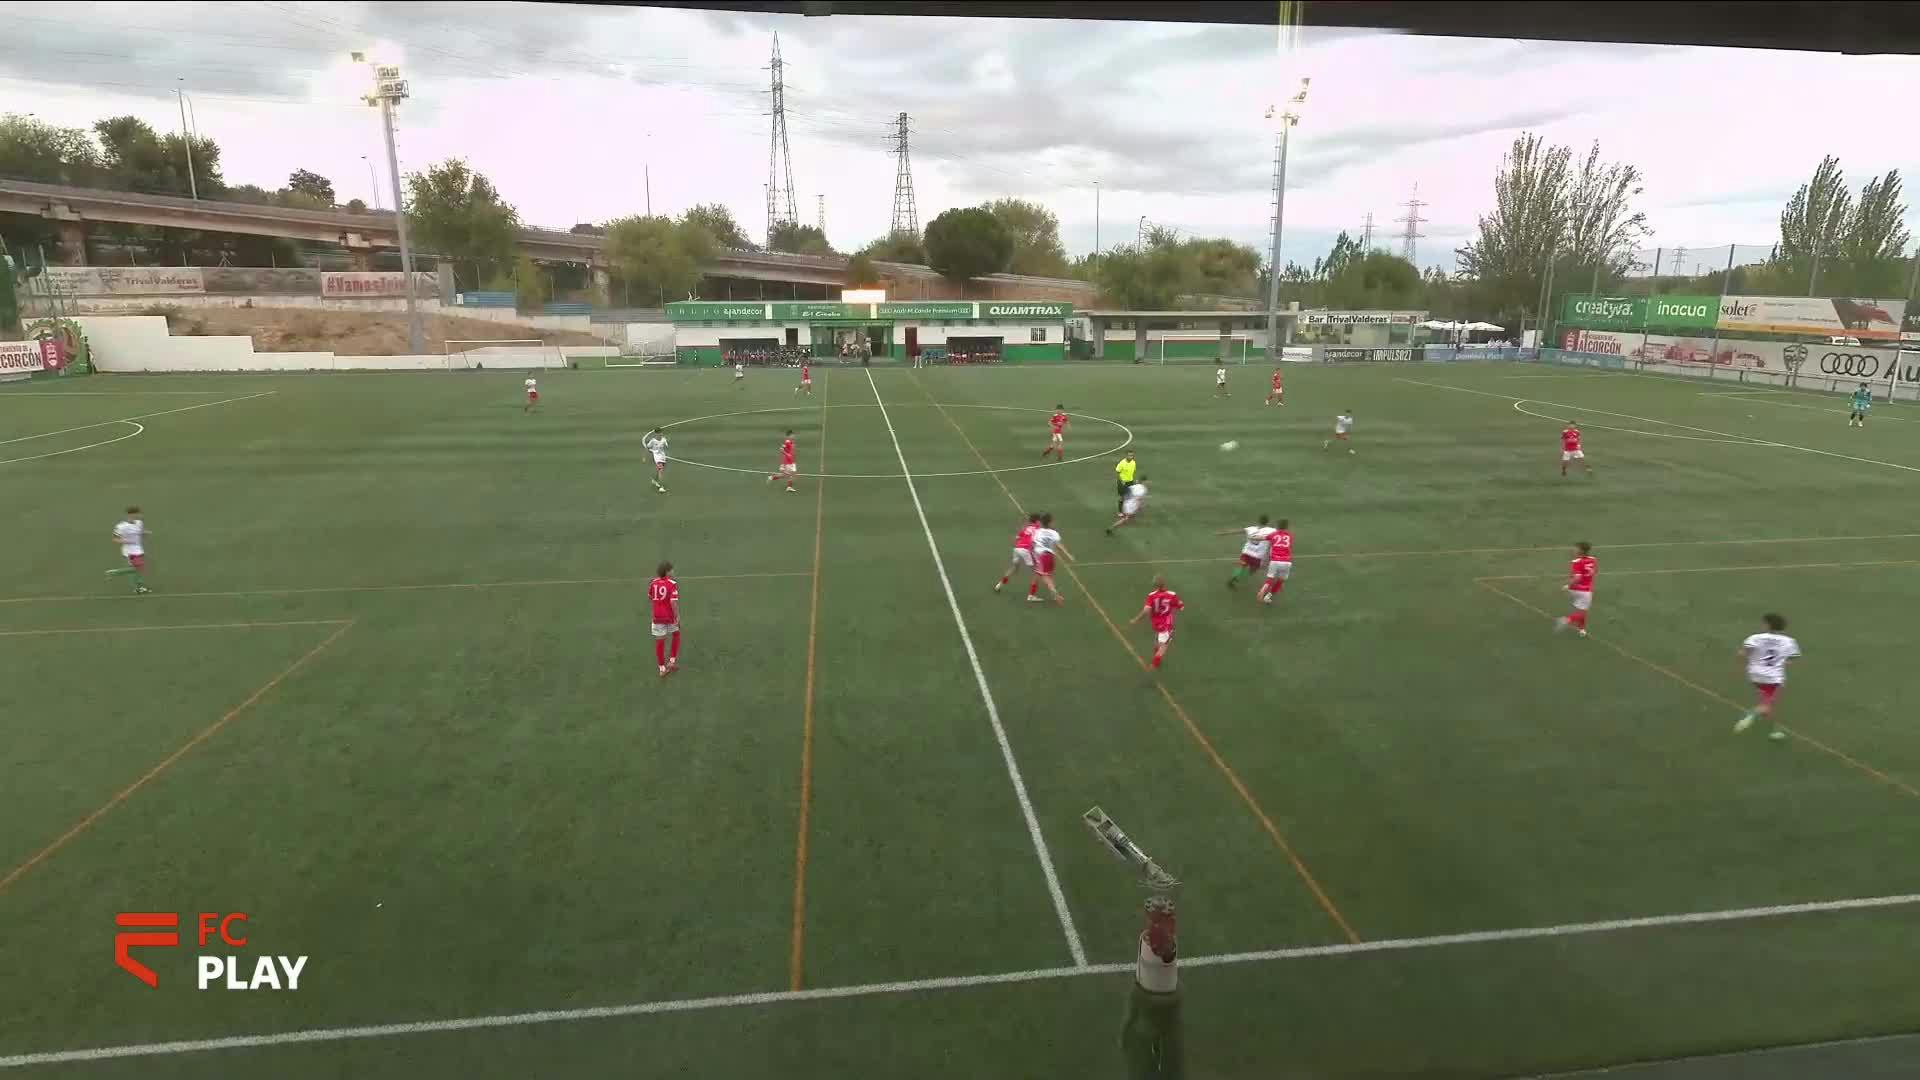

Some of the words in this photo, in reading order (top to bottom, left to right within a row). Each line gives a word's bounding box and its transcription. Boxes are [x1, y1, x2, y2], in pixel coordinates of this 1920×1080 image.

[989, 305, 1065, 316] QUAMTRAX
[1657, 301, 1708, 317] inacua
[1308, 315, 1324, 323] Bar
[1578, 338, 1622, 354] ALCORCÓN
[0, 348, 42, 369] CORCÓN
[1272, 534, 1291, 548] 23
[652, 583, 668, 601] 19
[1153, 597, 1171, 614] 15
